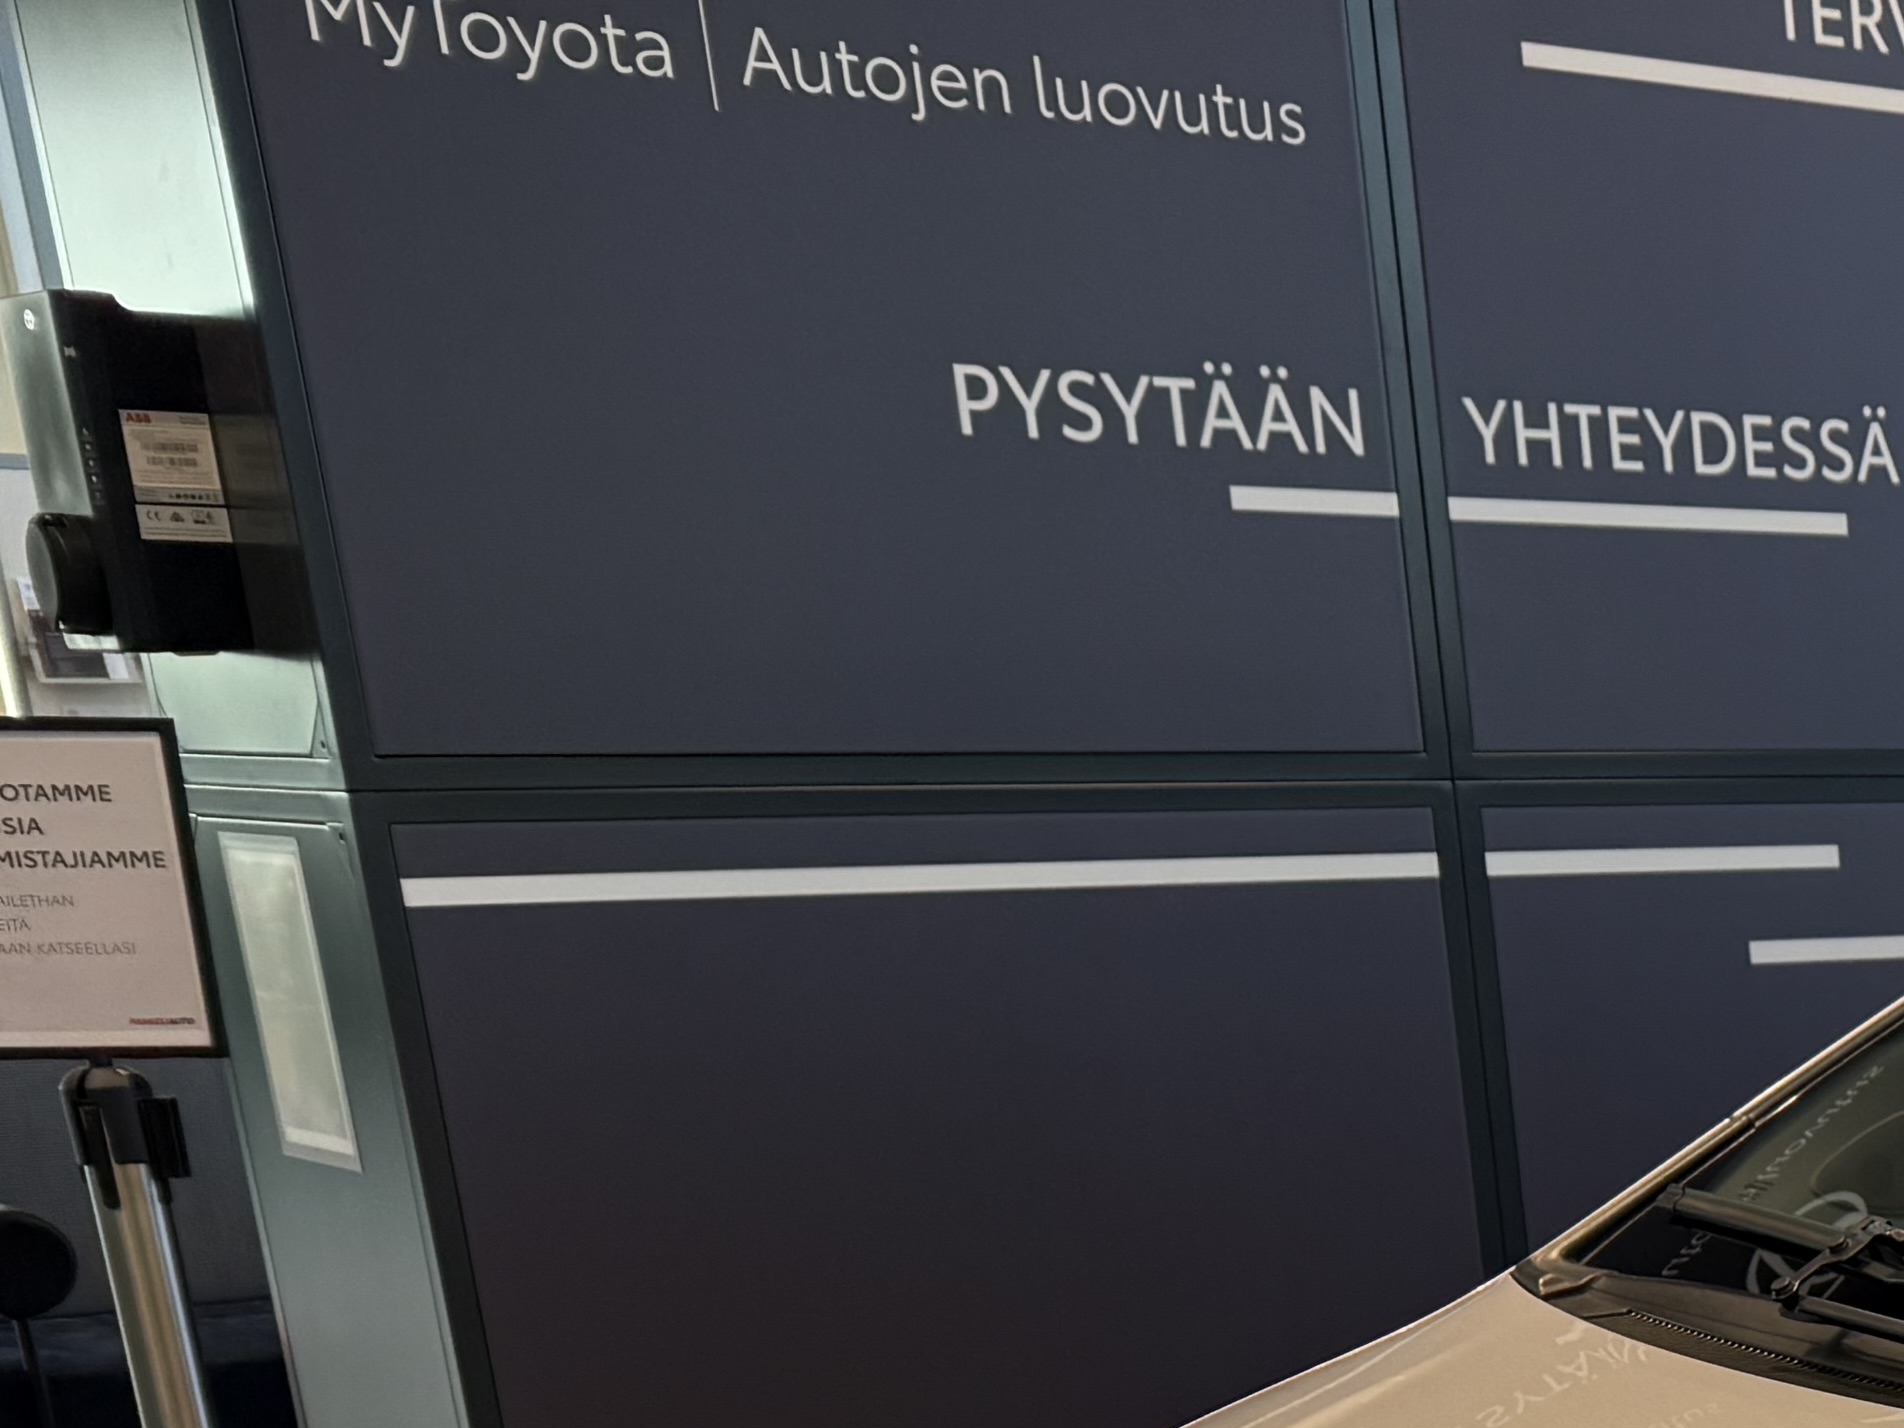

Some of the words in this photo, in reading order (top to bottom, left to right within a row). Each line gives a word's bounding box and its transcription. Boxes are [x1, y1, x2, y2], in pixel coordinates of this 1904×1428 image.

[742, 26, 1012, 121] Autojen
[1032, 55, 1306, 145] luovutus
[952, 361, 1366, 458] PYSYTÄÄN
[1462, 396, 1901, 485] YHTEYDESSÄ
